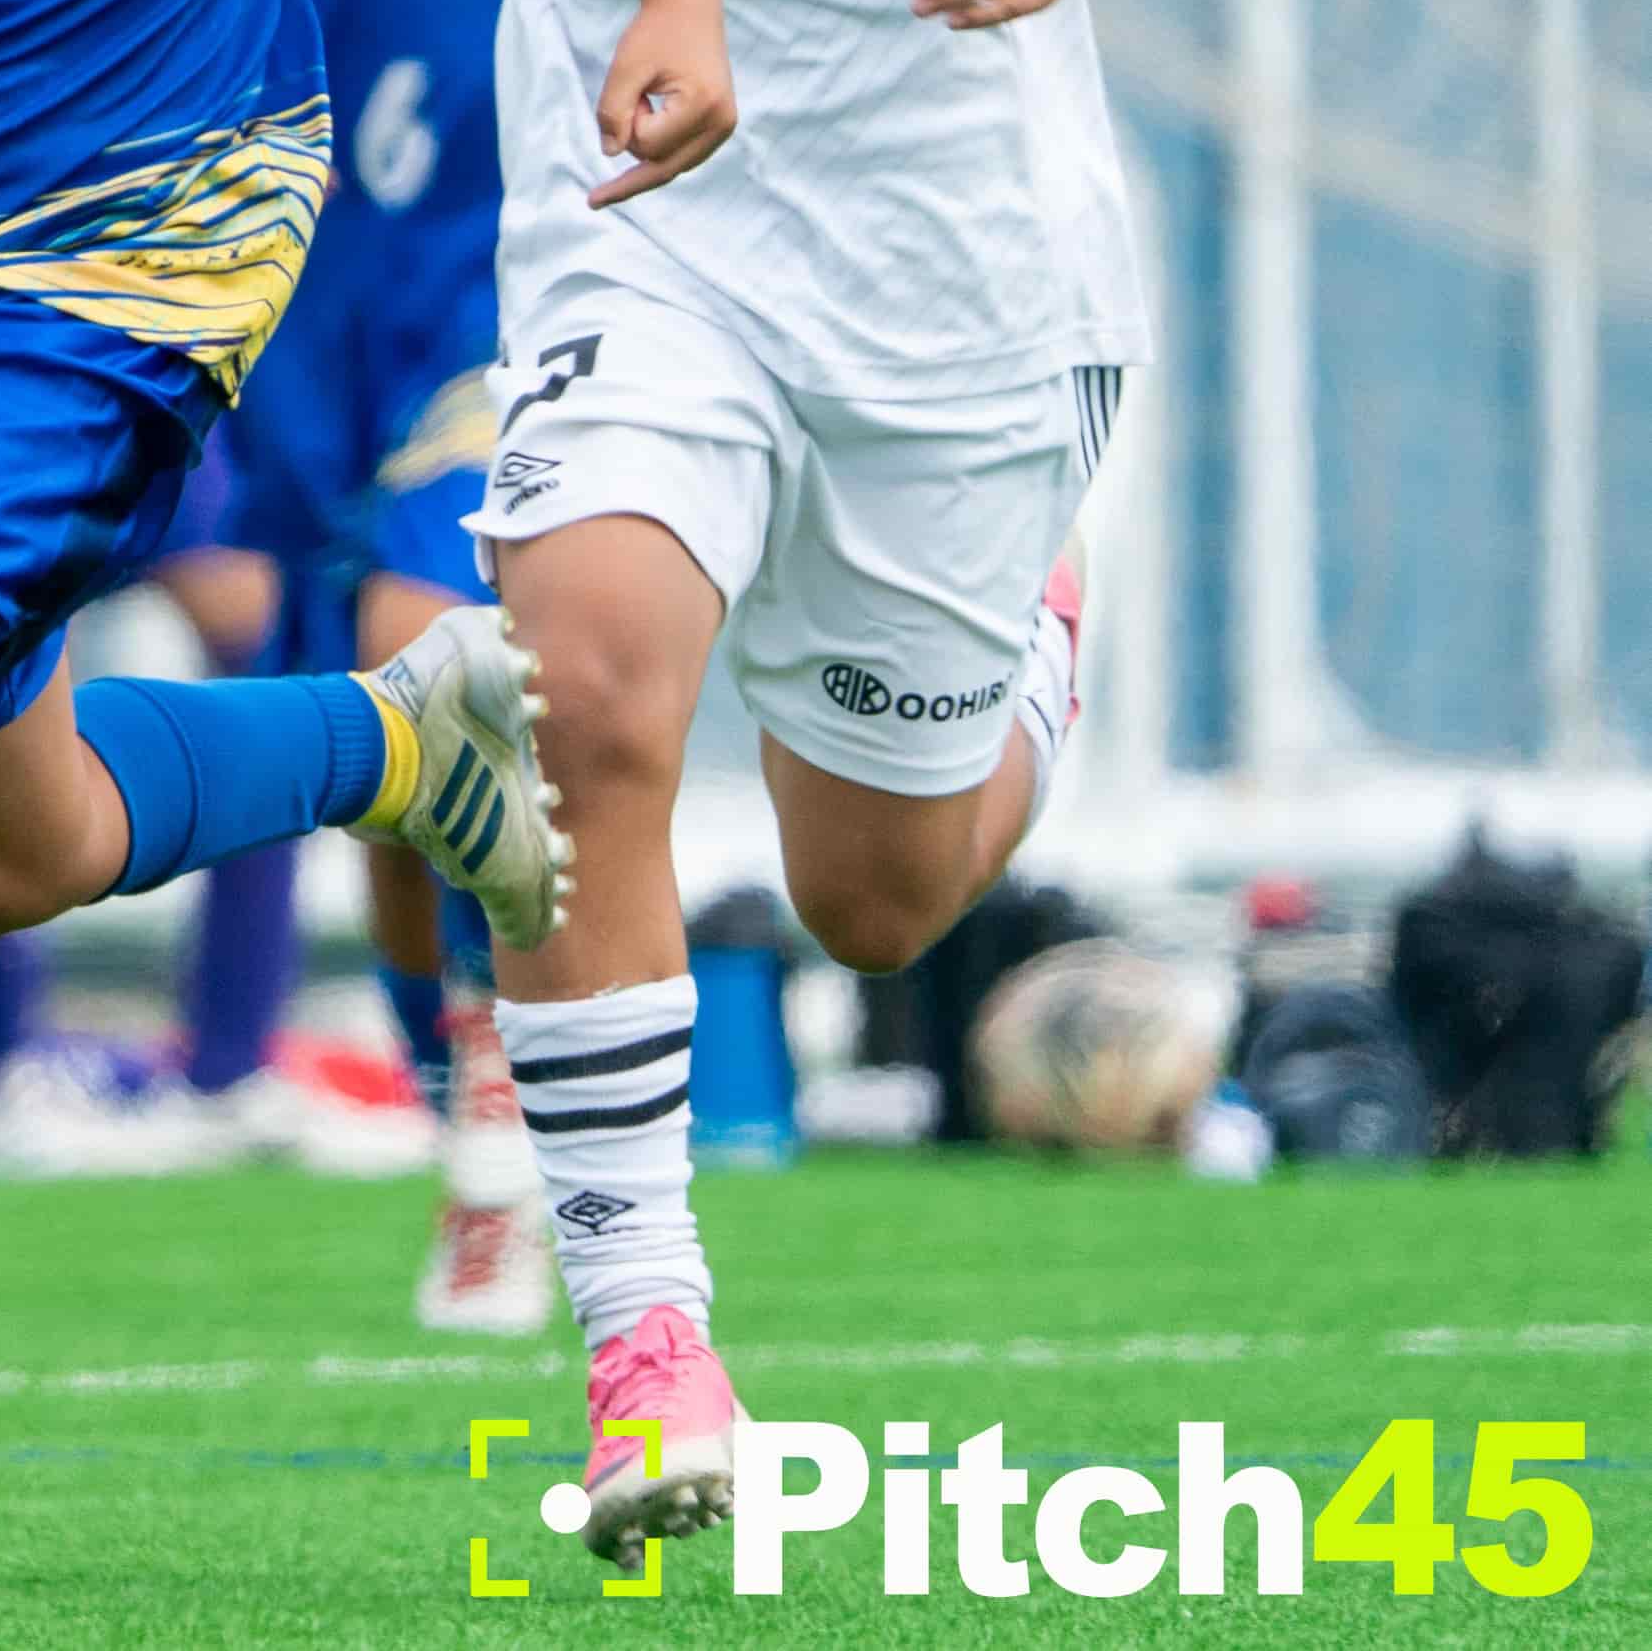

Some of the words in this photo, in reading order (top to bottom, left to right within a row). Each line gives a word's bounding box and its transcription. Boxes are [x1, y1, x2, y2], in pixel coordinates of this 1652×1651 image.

[353, 58, 440, 215] 6
[500, 332, 604, 440] 7
[895, 670, 1014, 722] OOHIR
